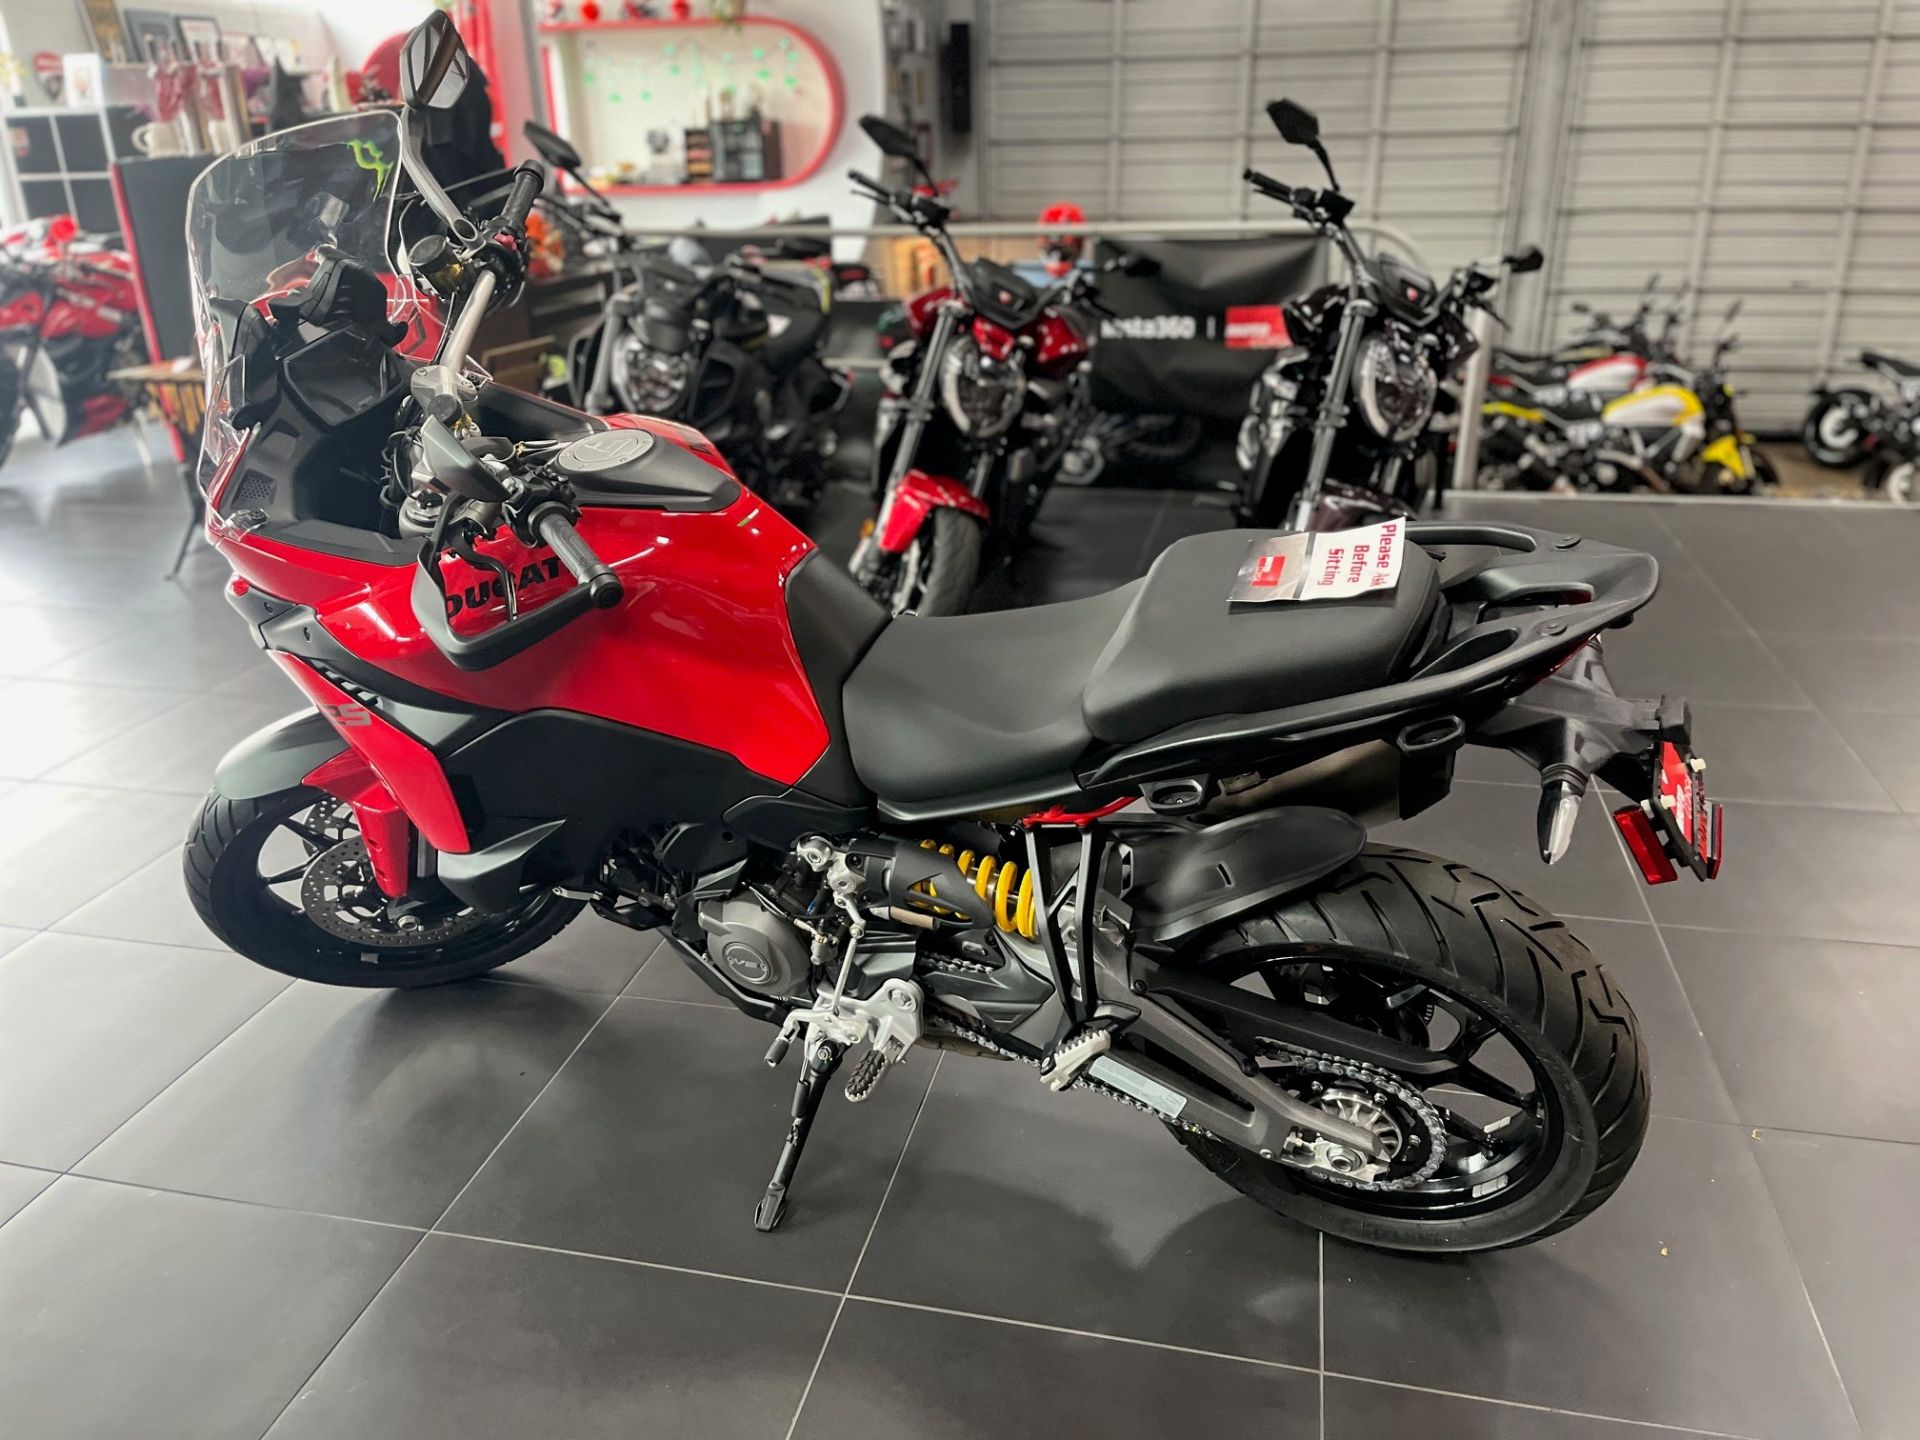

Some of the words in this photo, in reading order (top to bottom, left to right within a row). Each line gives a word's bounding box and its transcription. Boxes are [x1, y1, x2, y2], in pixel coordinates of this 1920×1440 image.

[1347, 544, 1370, 583] Before
[1376, 523, 1397, 568] Please
[445, 555, 564, 618] DUCAT
[1317, 548, 1344, 586] Sitting
